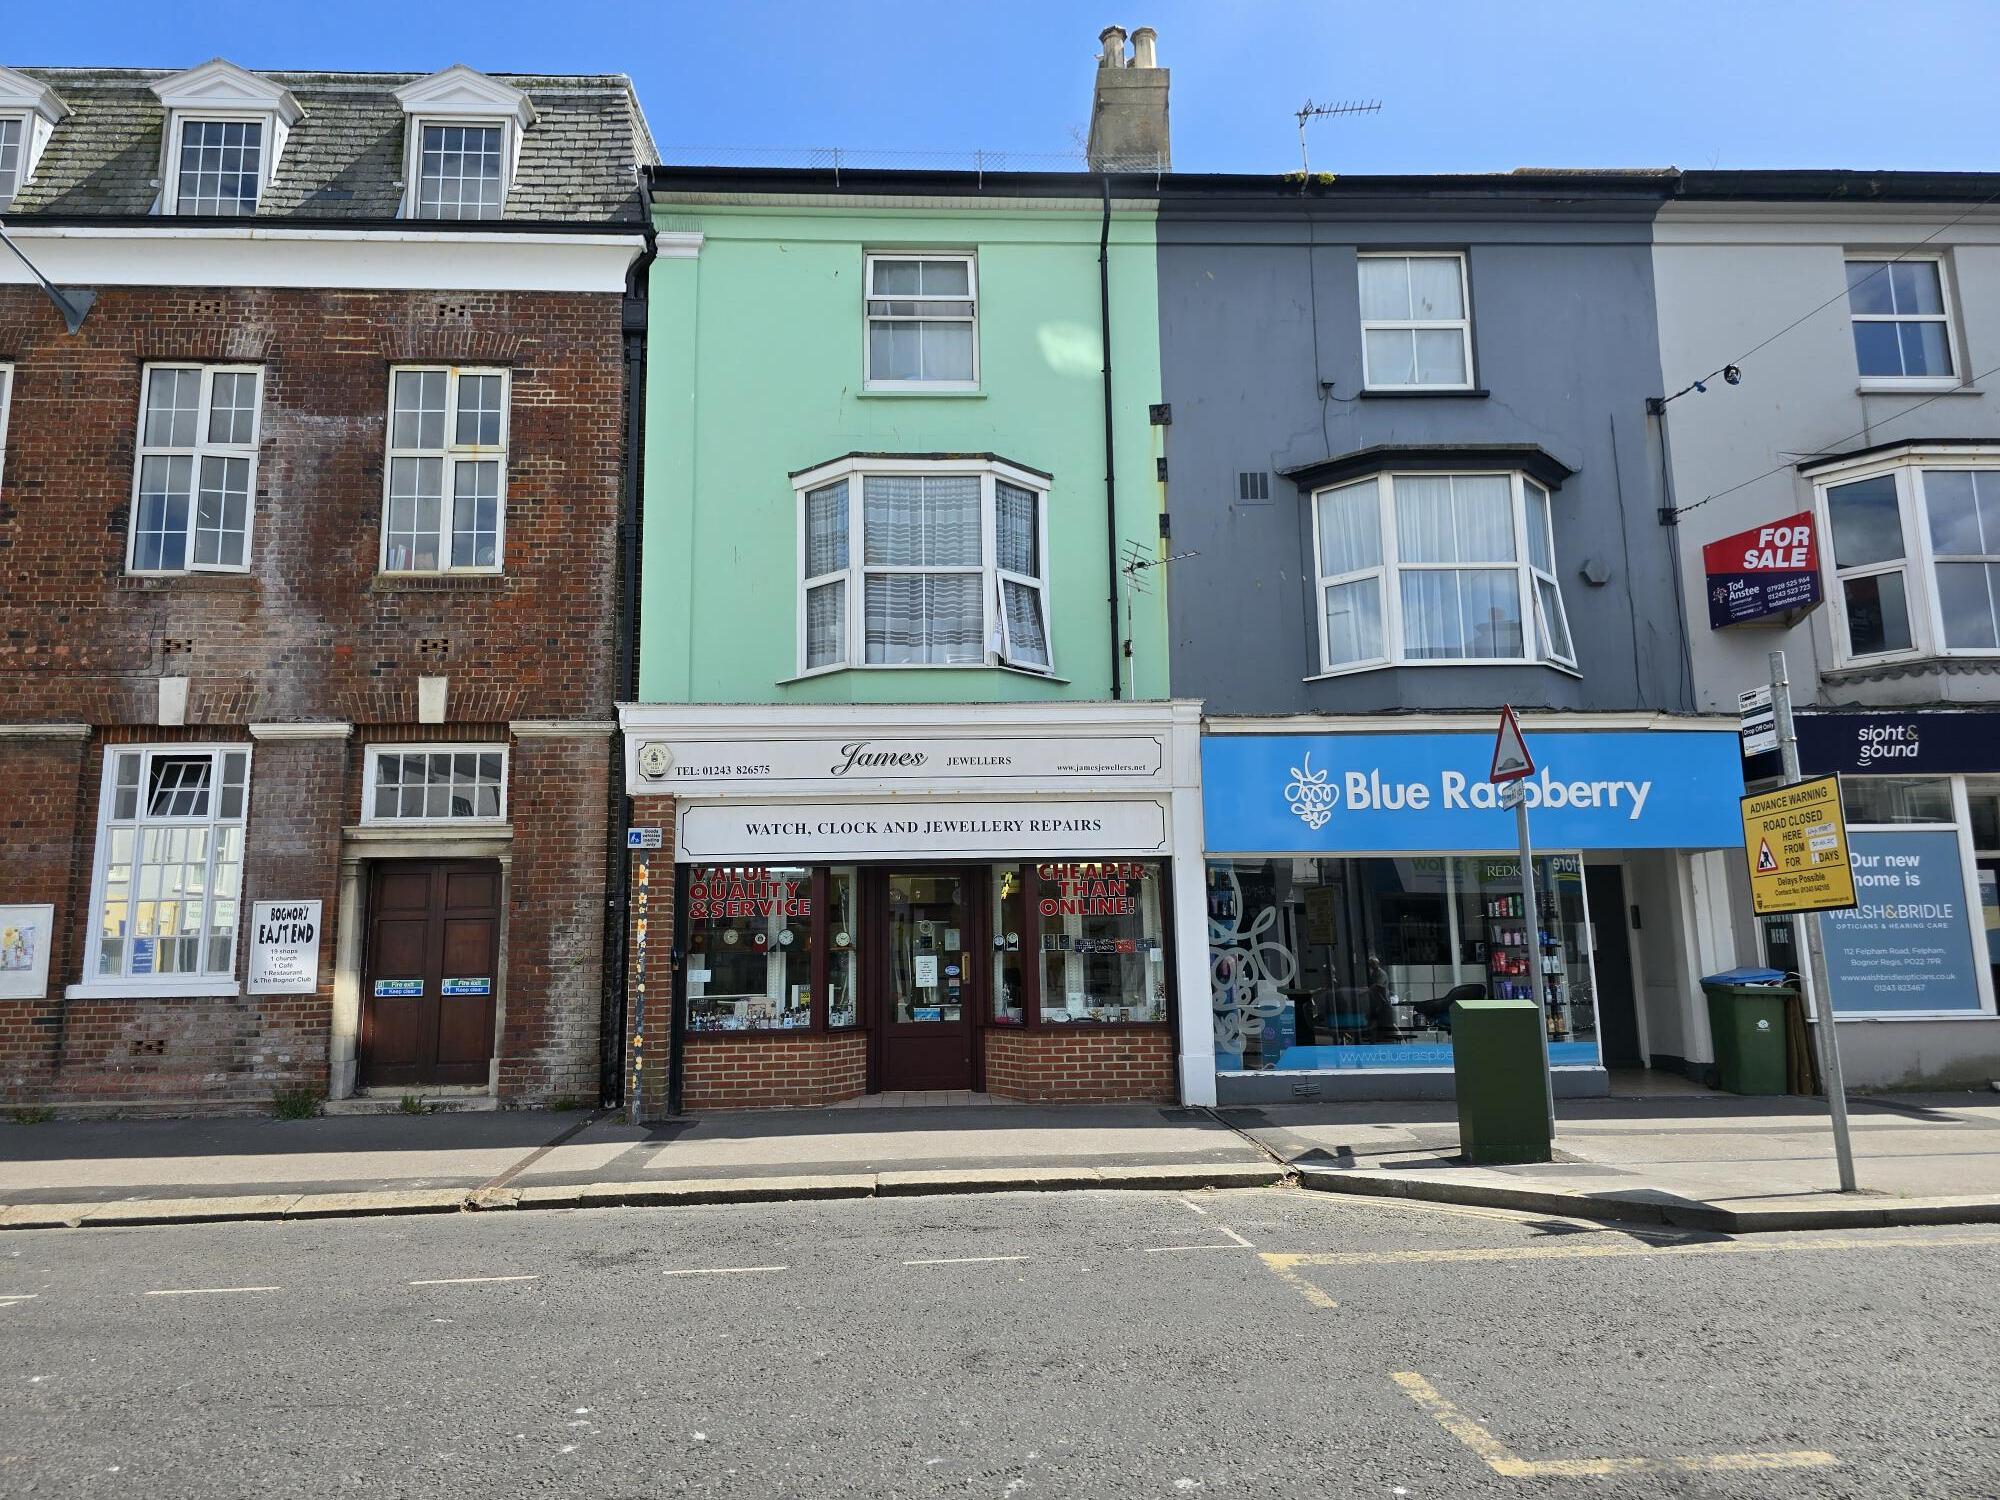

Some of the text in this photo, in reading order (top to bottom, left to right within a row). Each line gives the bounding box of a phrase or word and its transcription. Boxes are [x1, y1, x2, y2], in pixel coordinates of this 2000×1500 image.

[1759, 526, 1810, 548] FOR
[1743, 548, 1808, 569] SALE
[1727, 579, 1744, 591] Tod
[1766, 583, 1785, 593] 07928
[1786, 580, 1798, 588] 525
[1768, 583, 1811, 600] 01243 523 723
[1729, 586, 1760, 601] Anstee
[1768, 593, 1810, 608] todanstee.com
[1744, 728, 1755, 736] Drop
[1763, 721, 1774, 730] Only
[1858, 725, 1919, 742] sight &
[1860, 742, 1919, 757] sound
[830, 741, 928, 776] James
[946, 756, 1012, 766] JEWELLERS
[675, 765, 770, 776] TEL: 01243 826575
[1057, 763, 1146, 772] www.jamesjewellers.net
[1345, 768, 1430, 810] Blue
[1750, 786, 1828, 814] ADVANCE WARNING
[746, 819, 1102, 837] WATCH, CLOCK AND JEWELLERY REPAIRS
[1763, 809, 1823, 832] ROAD CLOSED
[1782, 829, 1802, 841] HERE
[1784, 842, 1805, 854] FROM
[1785, 856, 1801, 867] FOR
[1819, 850, 1840, 863] DAYS
[1850, 852, 1920, 867] Our new
[693, 865, 772, 882] VALUE
[1039, 863, 1146, 880] CHEAPER
[1487, 865, 1540, 877] REDKN
[1905, 871, 1920, 886] is
[1777, 872, 1826, 886] Delays Possible
[689, 881, 800, 900] QUALITY
[1058, 880, 1127, 897] THAN
[270, 905, 309, 921] BOGNOR'S
[1039, 897, 1135, 916] ONLINE!
[258, 923, 314, 945] EAST END
[1856, 948, 1888, 957] Felpham
[1889, 947, 1911, 955] Road,
[1912, 947, 1946, 956] Felpham,
[1851, 957, 1942, 967] Bognor Regis, PO22 7PR
[391, 980, 415, 988] Fire exit
[455, 986, 469, 994] Keep
[1873, 984, 1895, 992] 01243
[388, 988, 402, 996] Keep
